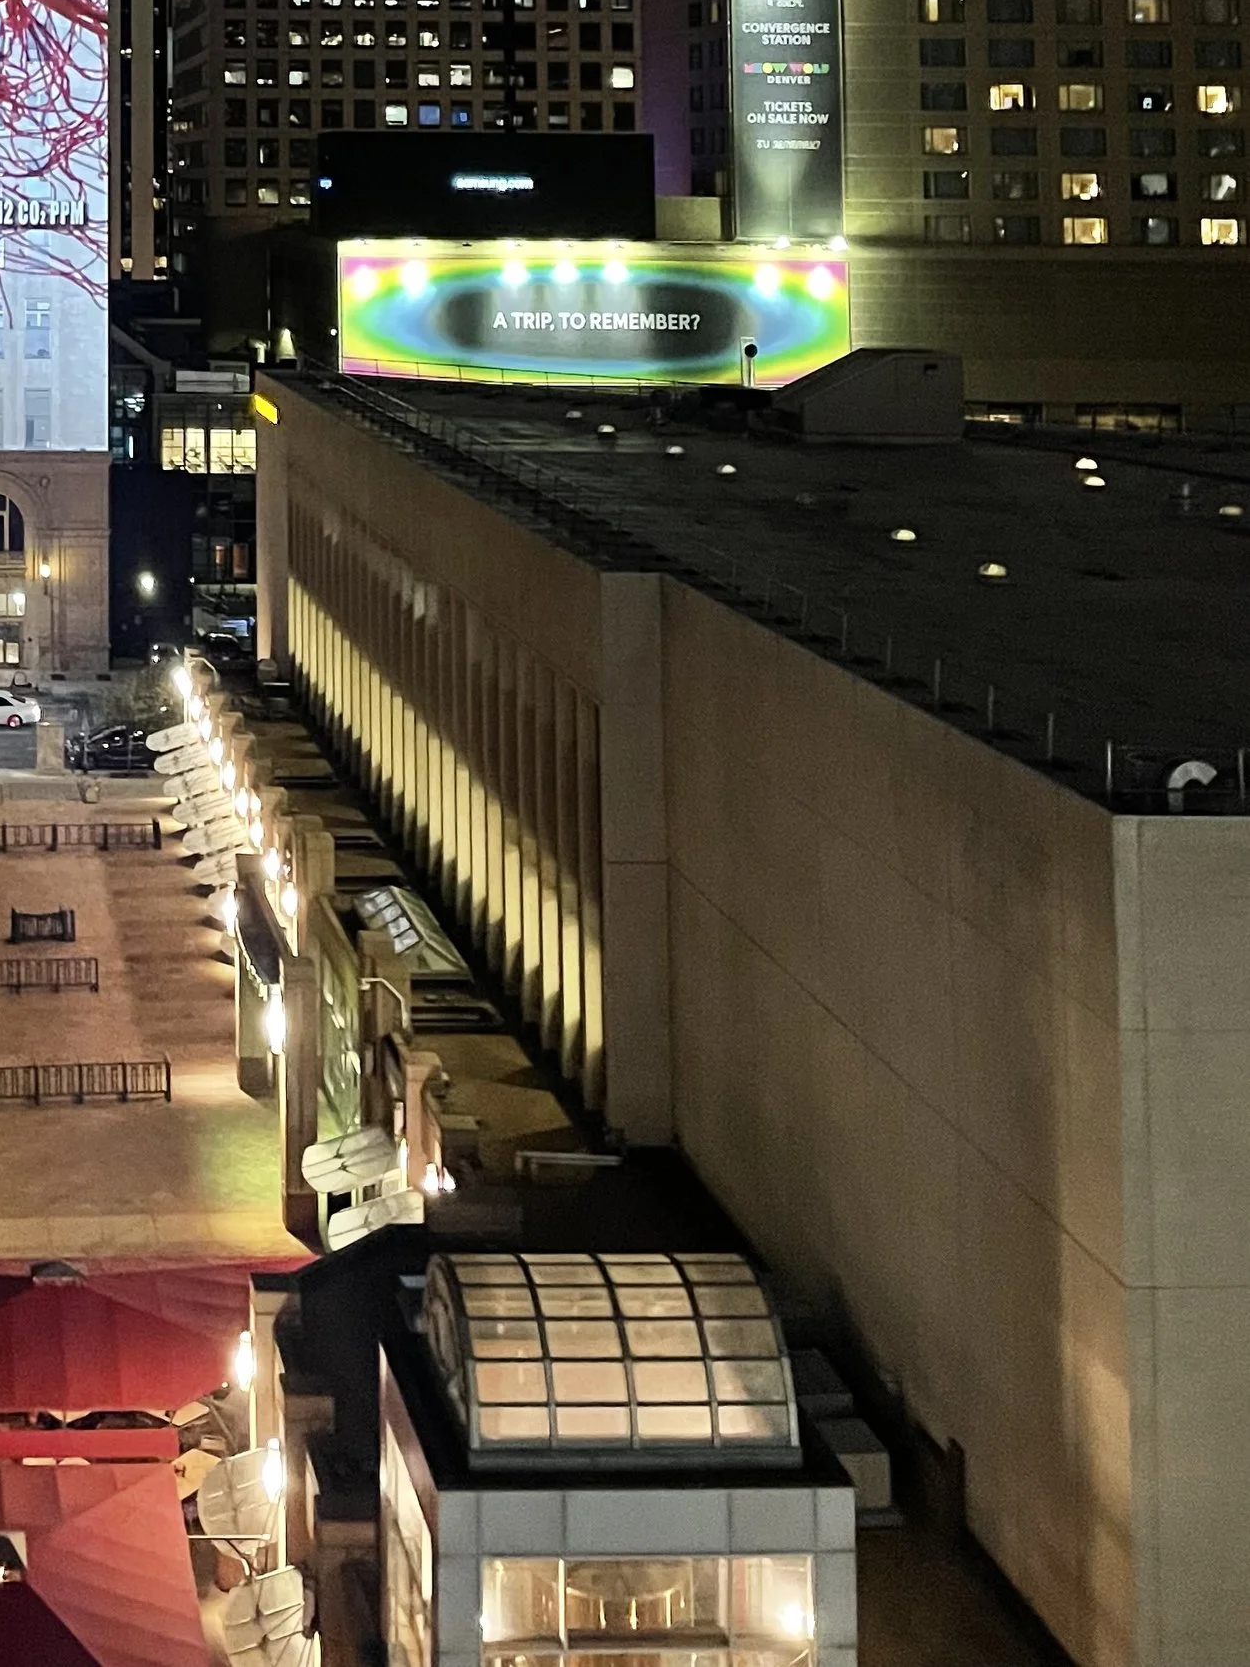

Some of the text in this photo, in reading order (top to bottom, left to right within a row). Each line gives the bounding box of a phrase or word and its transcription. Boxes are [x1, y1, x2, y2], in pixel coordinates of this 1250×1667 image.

[742, 22, 830, 34] CONVERGENCE
[762, 34, 811, 45] STATION
[767, 75, 811, 84] DENVER
[764, 101, 813, 112] TICKETS
[747, 113, 829, 124] ON SALE NOW
[50, 199, 85, 224] PPM
[492, 311, 701, 331] A TRIP, TO REMEMBER?
